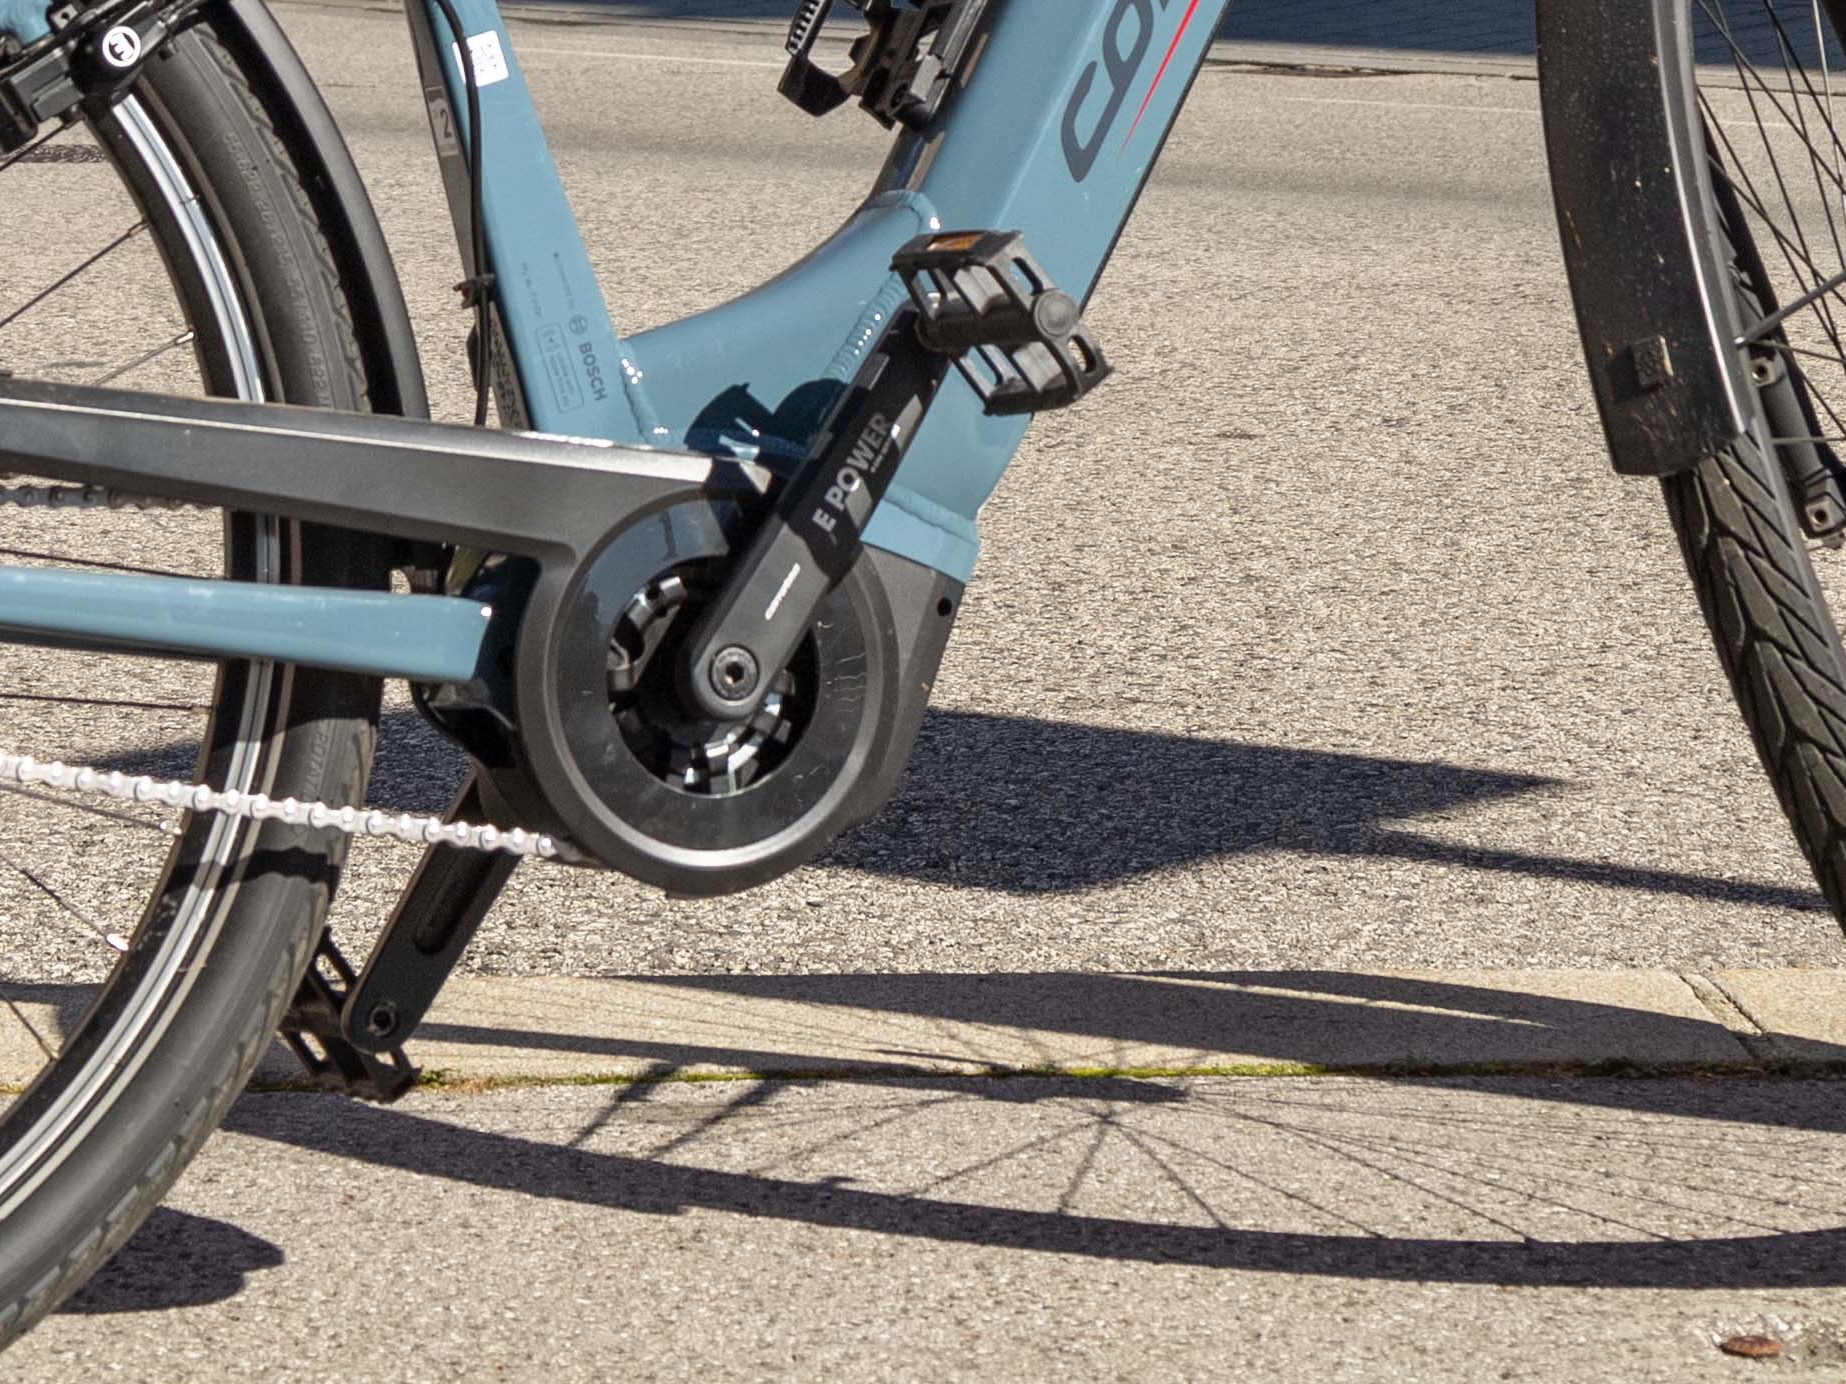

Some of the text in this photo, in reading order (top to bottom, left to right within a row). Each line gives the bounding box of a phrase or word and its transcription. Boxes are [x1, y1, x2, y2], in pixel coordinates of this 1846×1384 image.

[577, 341, 608, 403] BOSCH
[824, 413, 891, 512] POWER
[812, 507, 837, 532] E
